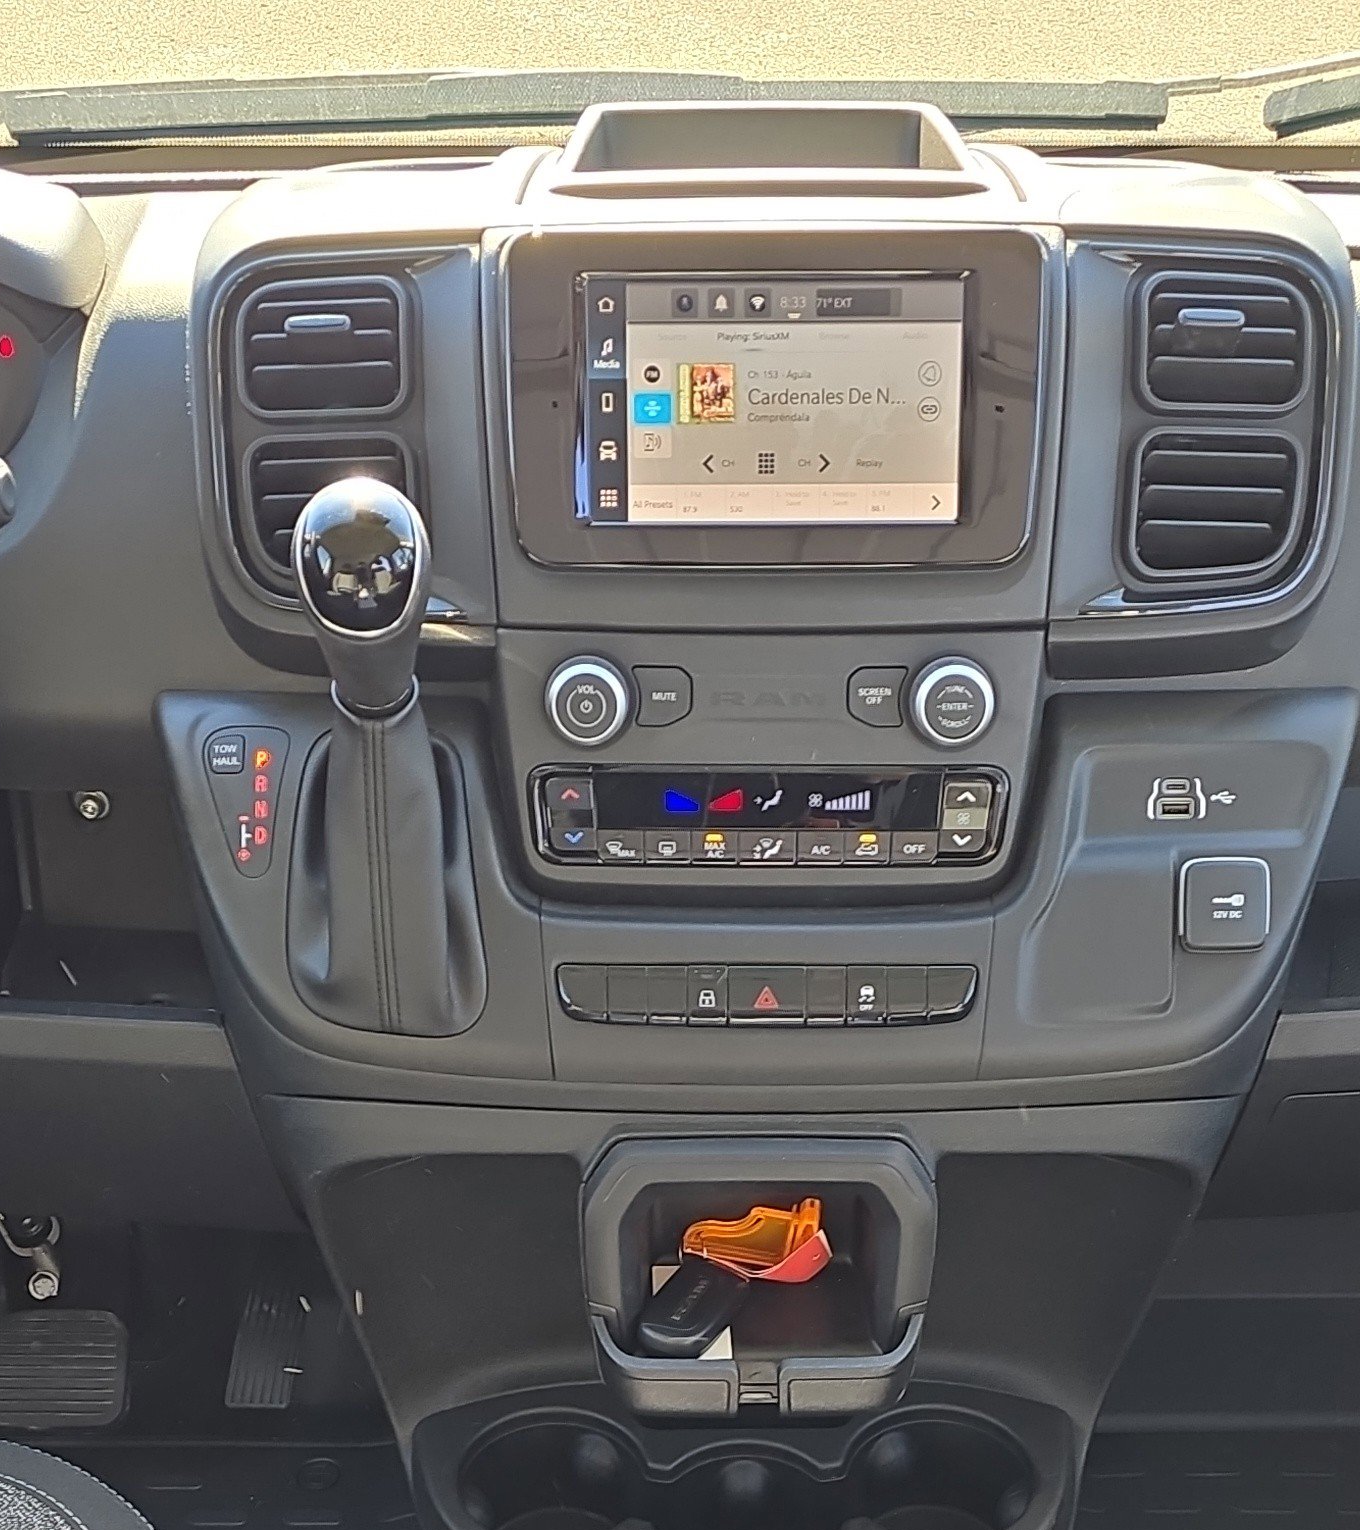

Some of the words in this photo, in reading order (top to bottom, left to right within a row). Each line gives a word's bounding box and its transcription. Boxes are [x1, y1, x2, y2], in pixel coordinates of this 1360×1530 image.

[717, 332, 748, 343] Playing:
[752, 332, 790, 340] SiriusXM
[593, 359, 621, 369] Media
[748, 388, 844, 405] Cardenales
[848, 388, 872, 405] De
[856, 458, 883, 469] Replay
[644, 501, 674, 509] Presets
[577, 685, 596, 695] VOL
[858, 687, 892, 697] SCREEN
[652, 692, 677, 701] MUTE
[865, 696, 883, 705] OFF
[213, 744, 238, 754] TOW
[212, 756, 242, 767] HAUL
[256, 750, 271, 767] P
[254, 826, 268, 844] D
[704, 842, 726, 850] MAX
[811, 845, 831, 855] A/C
[902, 844, 926, 854] OFF
[706, 850, 725, 858] A/C
[1228, 910, 1243, 919] DC
